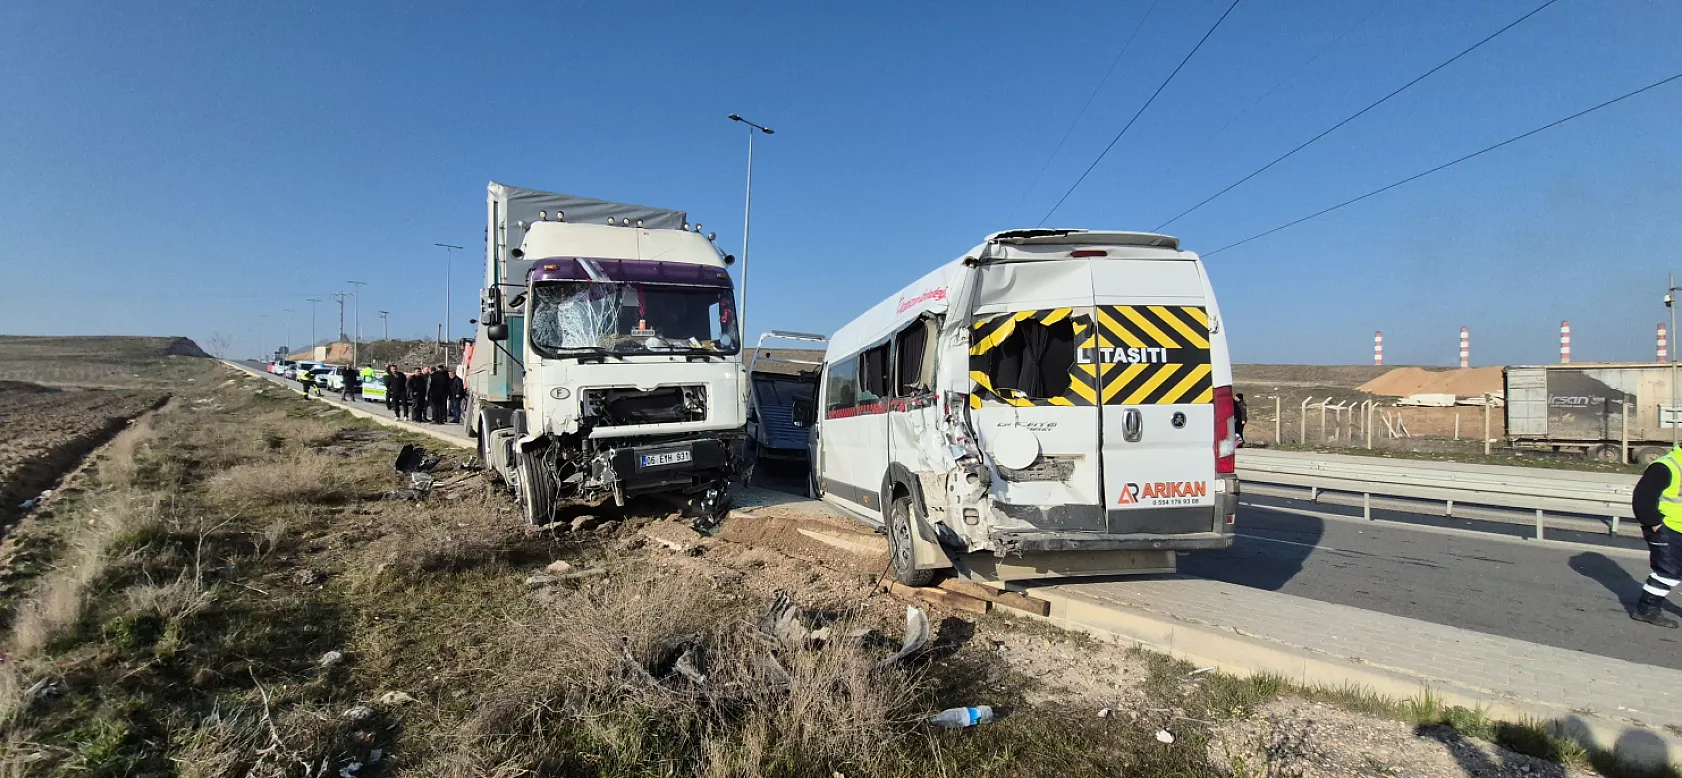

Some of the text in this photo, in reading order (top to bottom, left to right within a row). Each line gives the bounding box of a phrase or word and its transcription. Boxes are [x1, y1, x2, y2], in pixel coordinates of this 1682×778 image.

[1099, 347, 1168, 365] TAŞITI
[556, 389, 562, 397] F
[1141, 481, 1207, 499] ARIKAN
